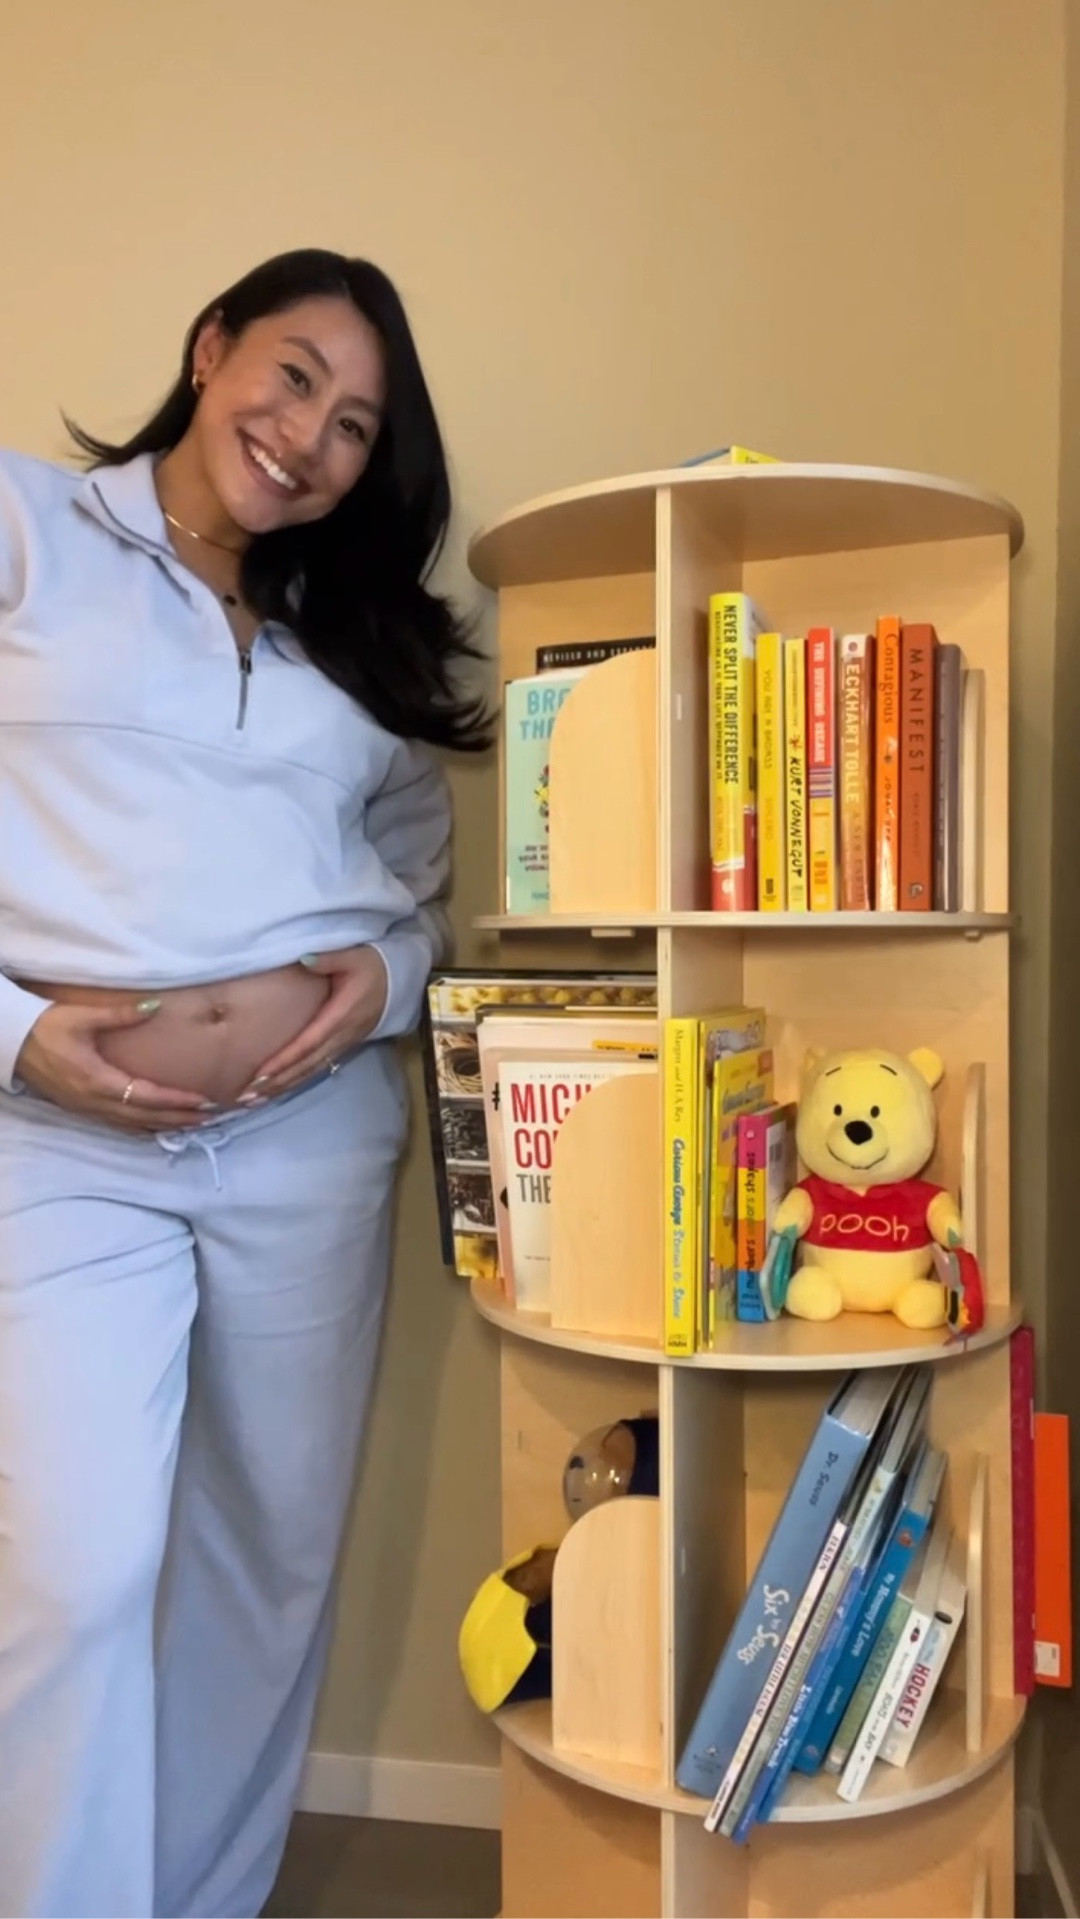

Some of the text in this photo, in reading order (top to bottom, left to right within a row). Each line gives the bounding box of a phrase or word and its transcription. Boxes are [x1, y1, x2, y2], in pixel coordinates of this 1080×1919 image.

[724, 605, 739, 784] NEVER SPLIT THE DIFFERENCE
[814, 642, 825, 763] THE DEFINING DECADE
[881, 633, 897, 723] Contagious
[845, 664, 860, 804] ECKHART TOLLE
[909, 648, 924, 774] MANIFEST
[790, 756, 802, 878] KURT VONNEGUT
[514, 1128, 559, 1169] CO
[672, 1138, 685, 1183] Curious
[670, 1185, 685, 1226] George
[820, 1213, 909, 1242] pooh
[810, 1451, 839, 1507] Dr. Seuss
[763, 1585, 790, 1620] Six
[737, 1621, 781, 1667] Seuss
[852, 1631, 868, 1655] Love
[896, 1663, 930, 1728] HOCKEY
